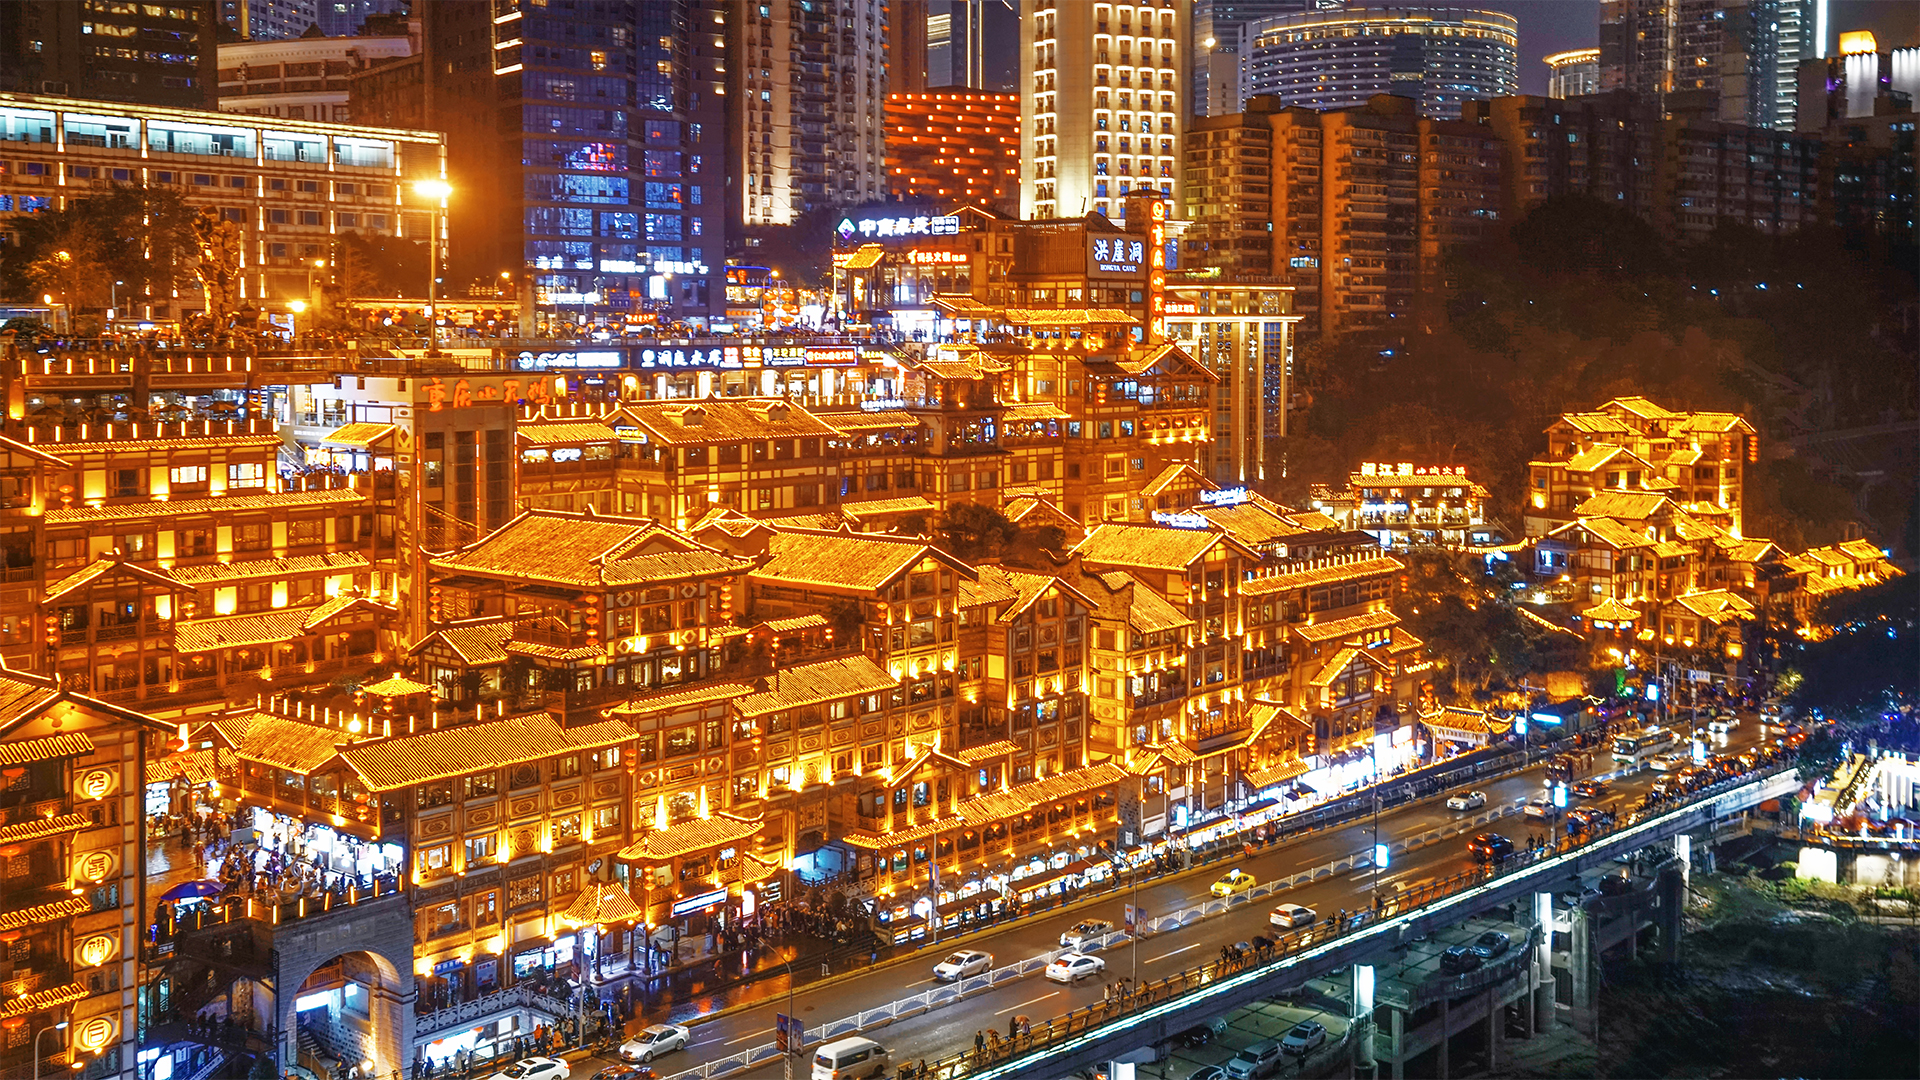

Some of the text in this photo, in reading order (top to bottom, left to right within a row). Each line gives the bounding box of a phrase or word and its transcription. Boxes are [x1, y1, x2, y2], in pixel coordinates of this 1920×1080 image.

[1093, 238, 1144, 264] 洪崖洞
[1100, 263, 1137, 273] HONGYA CAVE
[1152, 224, 1165, 337] 重庆小天鹅
[420, 376, 551, 413] 重庆小天鹅
